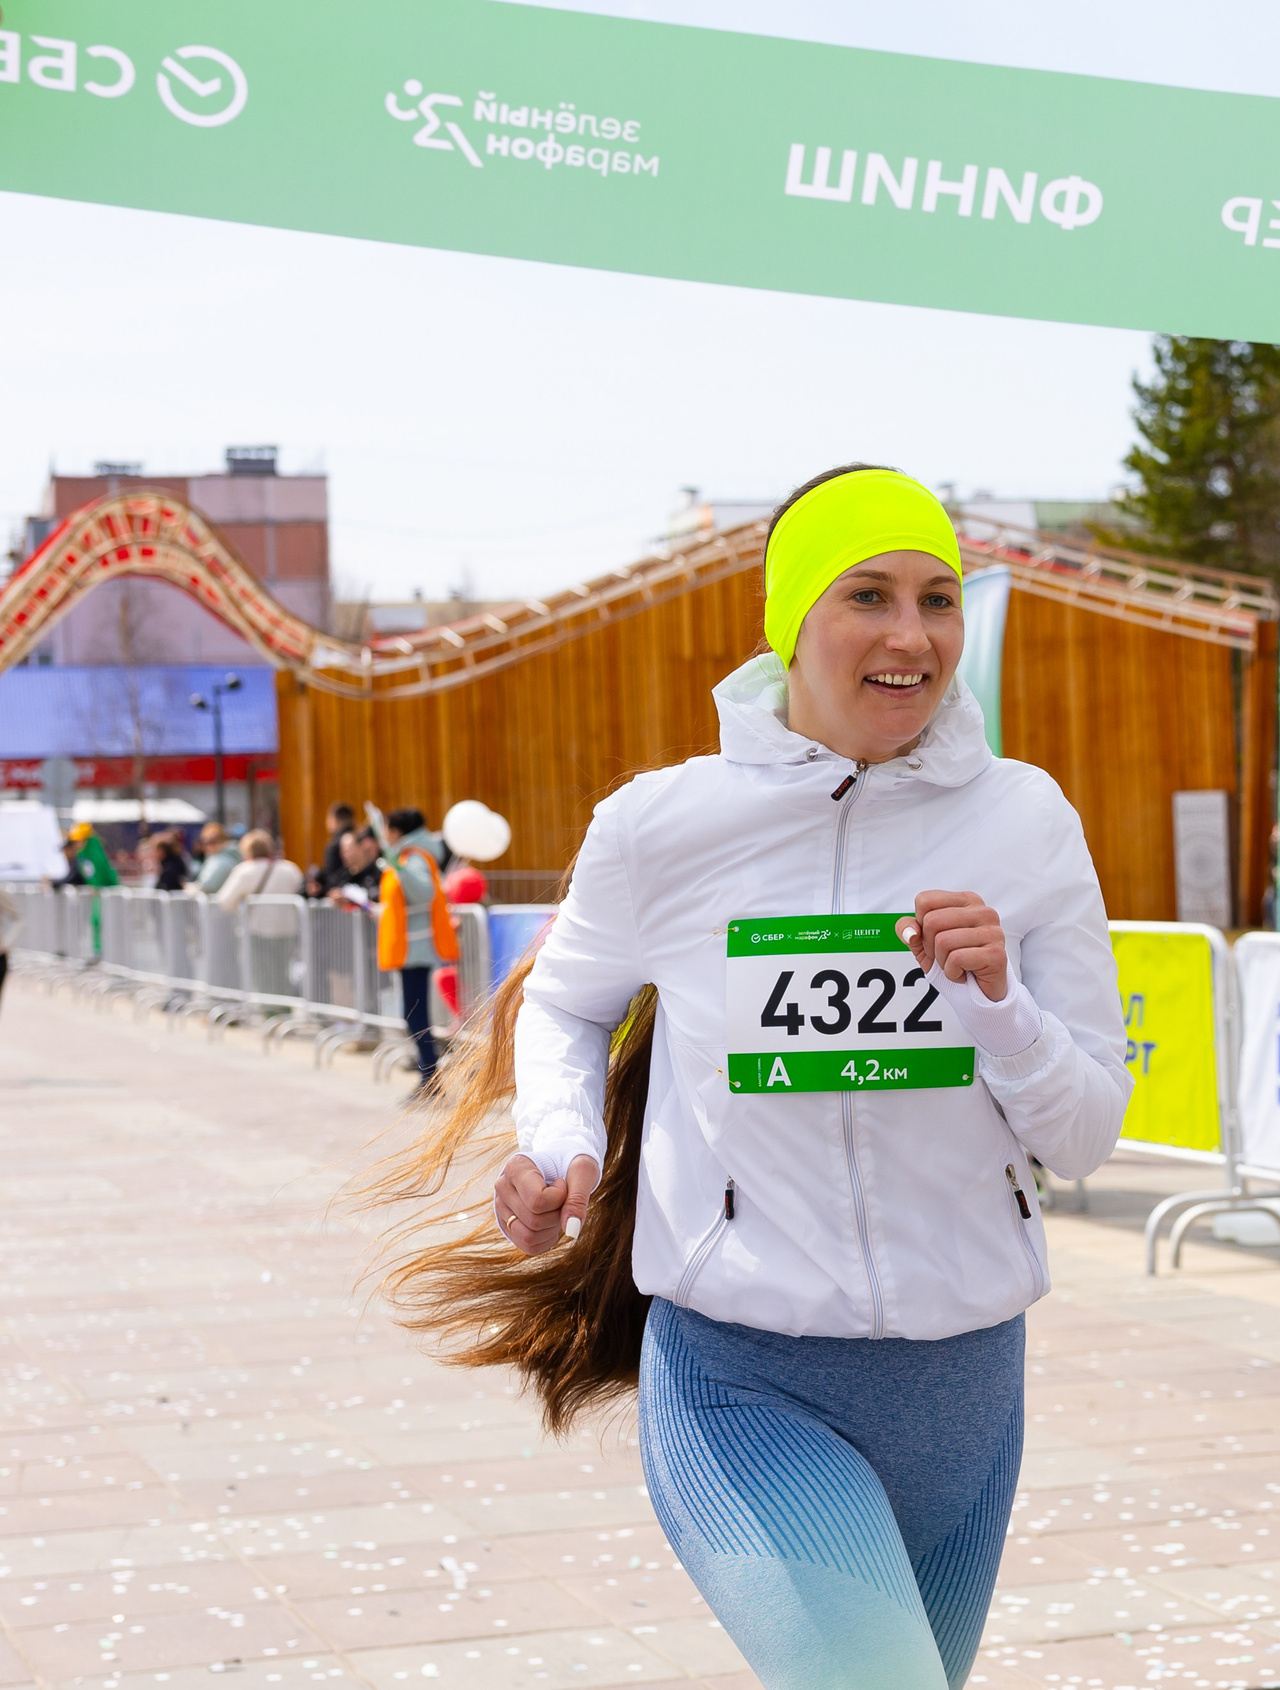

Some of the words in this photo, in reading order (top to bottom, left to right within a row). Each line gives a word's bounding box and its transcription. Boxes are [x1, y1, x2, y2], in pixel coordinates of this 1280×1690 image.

[762, 933, 784, 941] СБЕР
[760, 968, 943, 1036] 4322
[840, 1059, 881, 1085] 4,2
